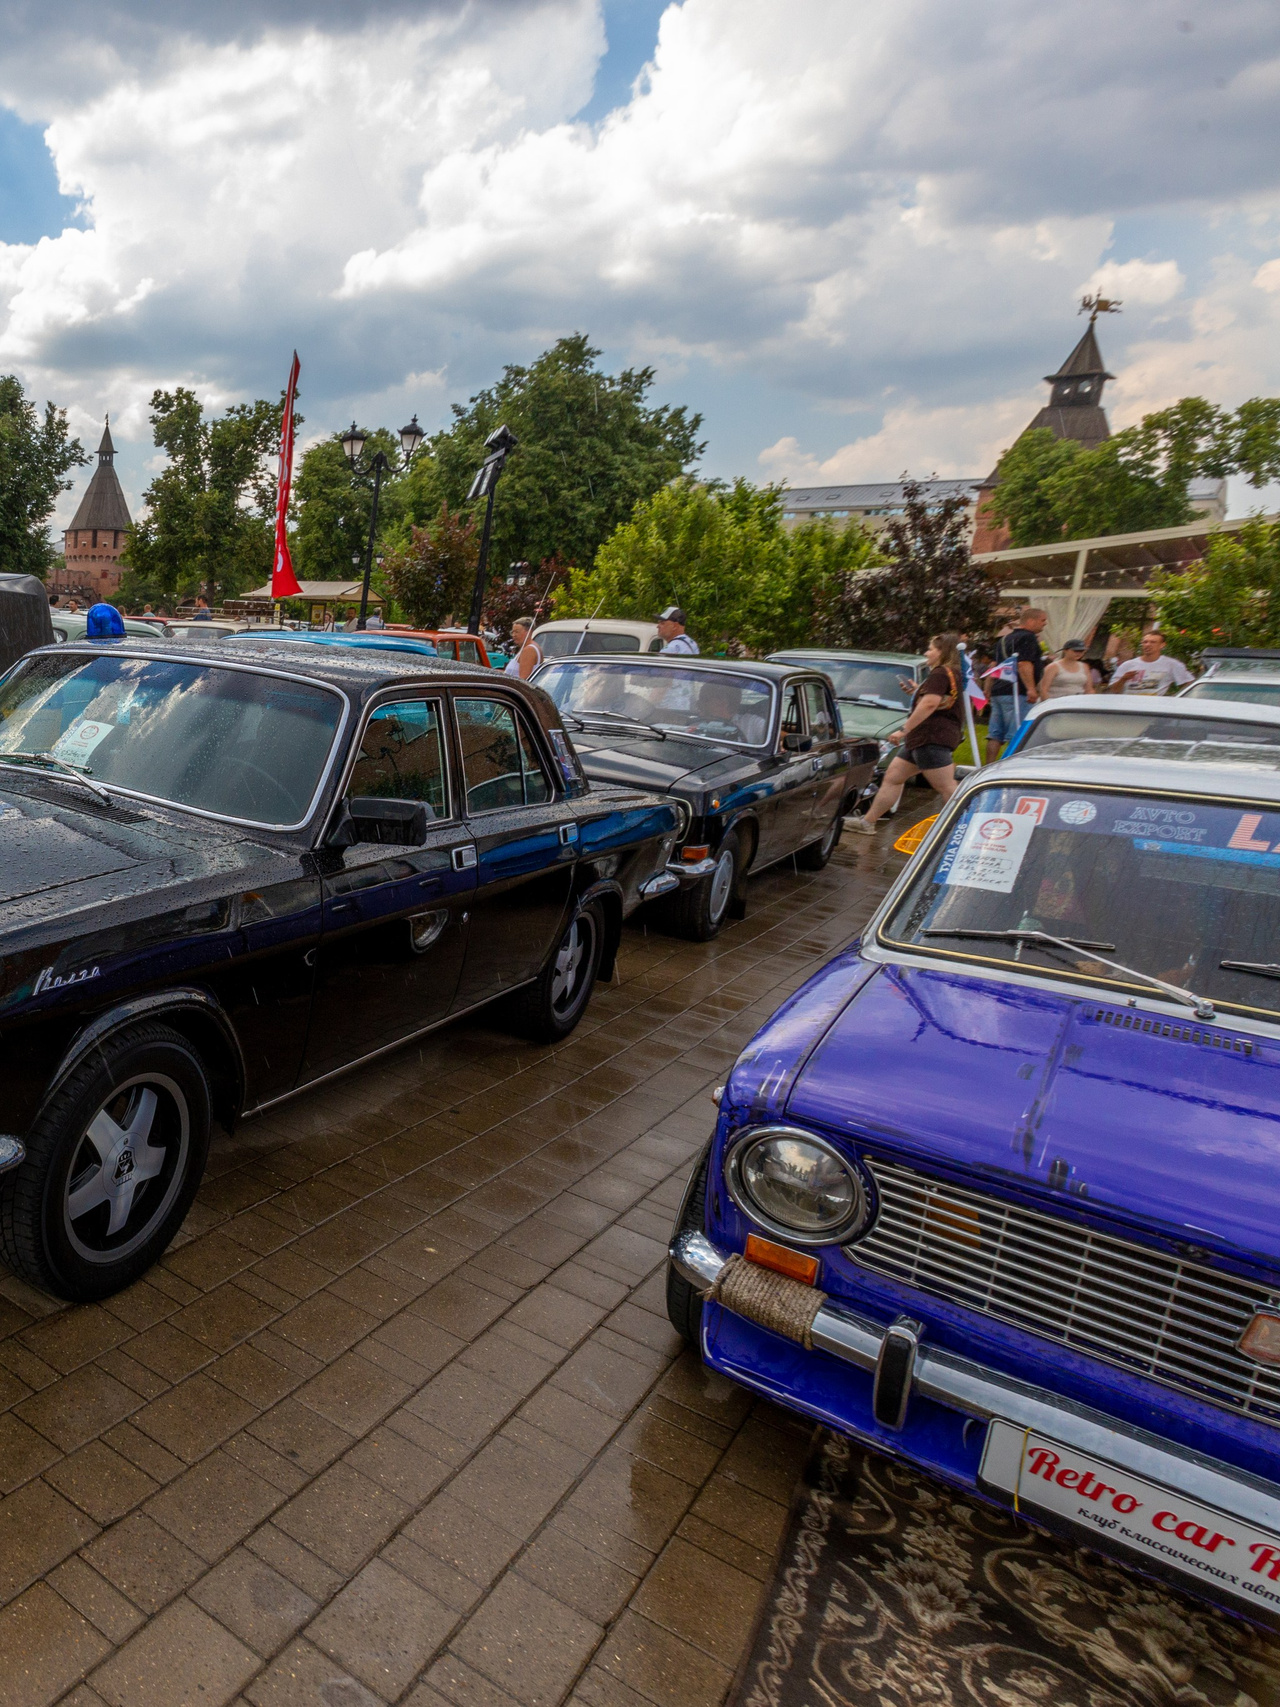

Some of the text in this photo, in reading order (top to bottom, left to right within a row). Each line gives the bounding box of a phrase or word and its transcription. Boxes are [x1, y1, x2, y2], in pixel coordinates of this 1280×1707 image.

[1111, 819, 1208, 842] EXPORT
[1129, 806, 1196, 824] AVTO
[1227, 813, 1280, 853] L
[939, 823, 968, 874] ТУЛА 2026
[32, 966, 101, 996] Волга
[1027, 1447, 1144, 1514] Retro
[1151, 1510, 1236, 1553] car
[1077, 1506, 1121, 1530] клуб
[1119, 1526, 1240, 1586] классических
